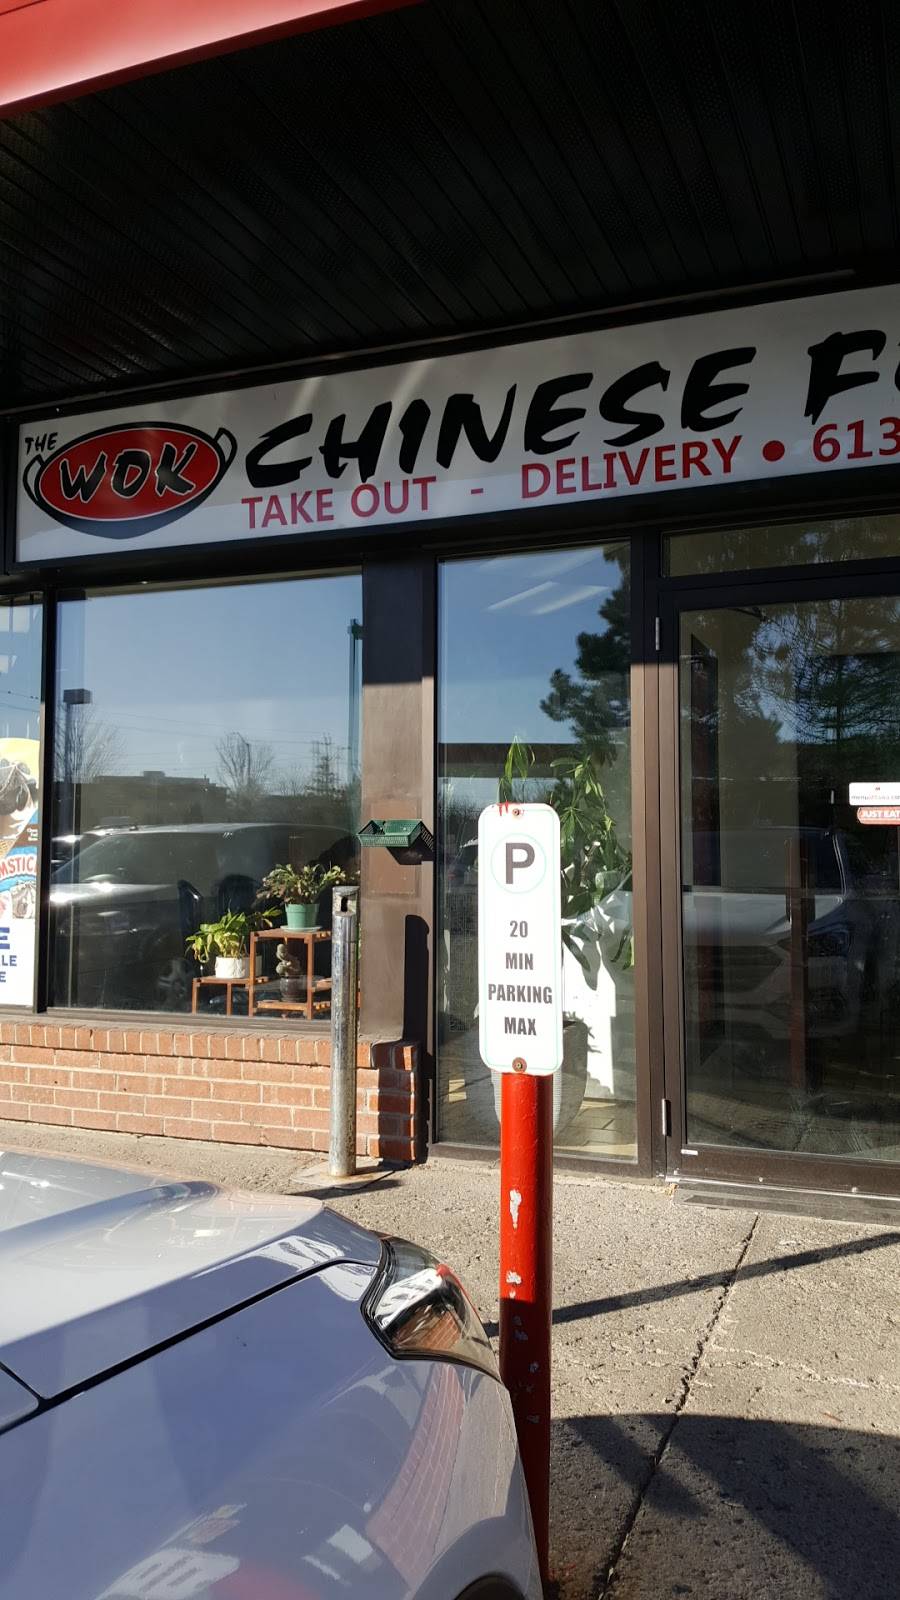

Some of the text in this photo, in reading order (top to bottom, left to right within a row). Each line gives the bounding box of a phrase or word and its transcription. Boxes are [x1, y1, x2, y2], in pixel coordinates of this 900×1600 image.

[245, 329, 900, 488] CHINESE F
[24, 432, 59, 454] THE
[58, 442, 199, 503] WOK
[241, 488, 335, 529] TAKE
[350, 476, 437, 517] OUT
[521, 435, 743, 499] DELIVERY
[812, 416, 900, 463] 613
[862, 809, 881, 818] JUST
[505, 842, 536, 885] P
[509, 920, 529, 938] 20
[505, 952, 534, 971] MIN
[488, 983, 553, 1004] PARKING
[504, 1016, 537, 1036] MAX
